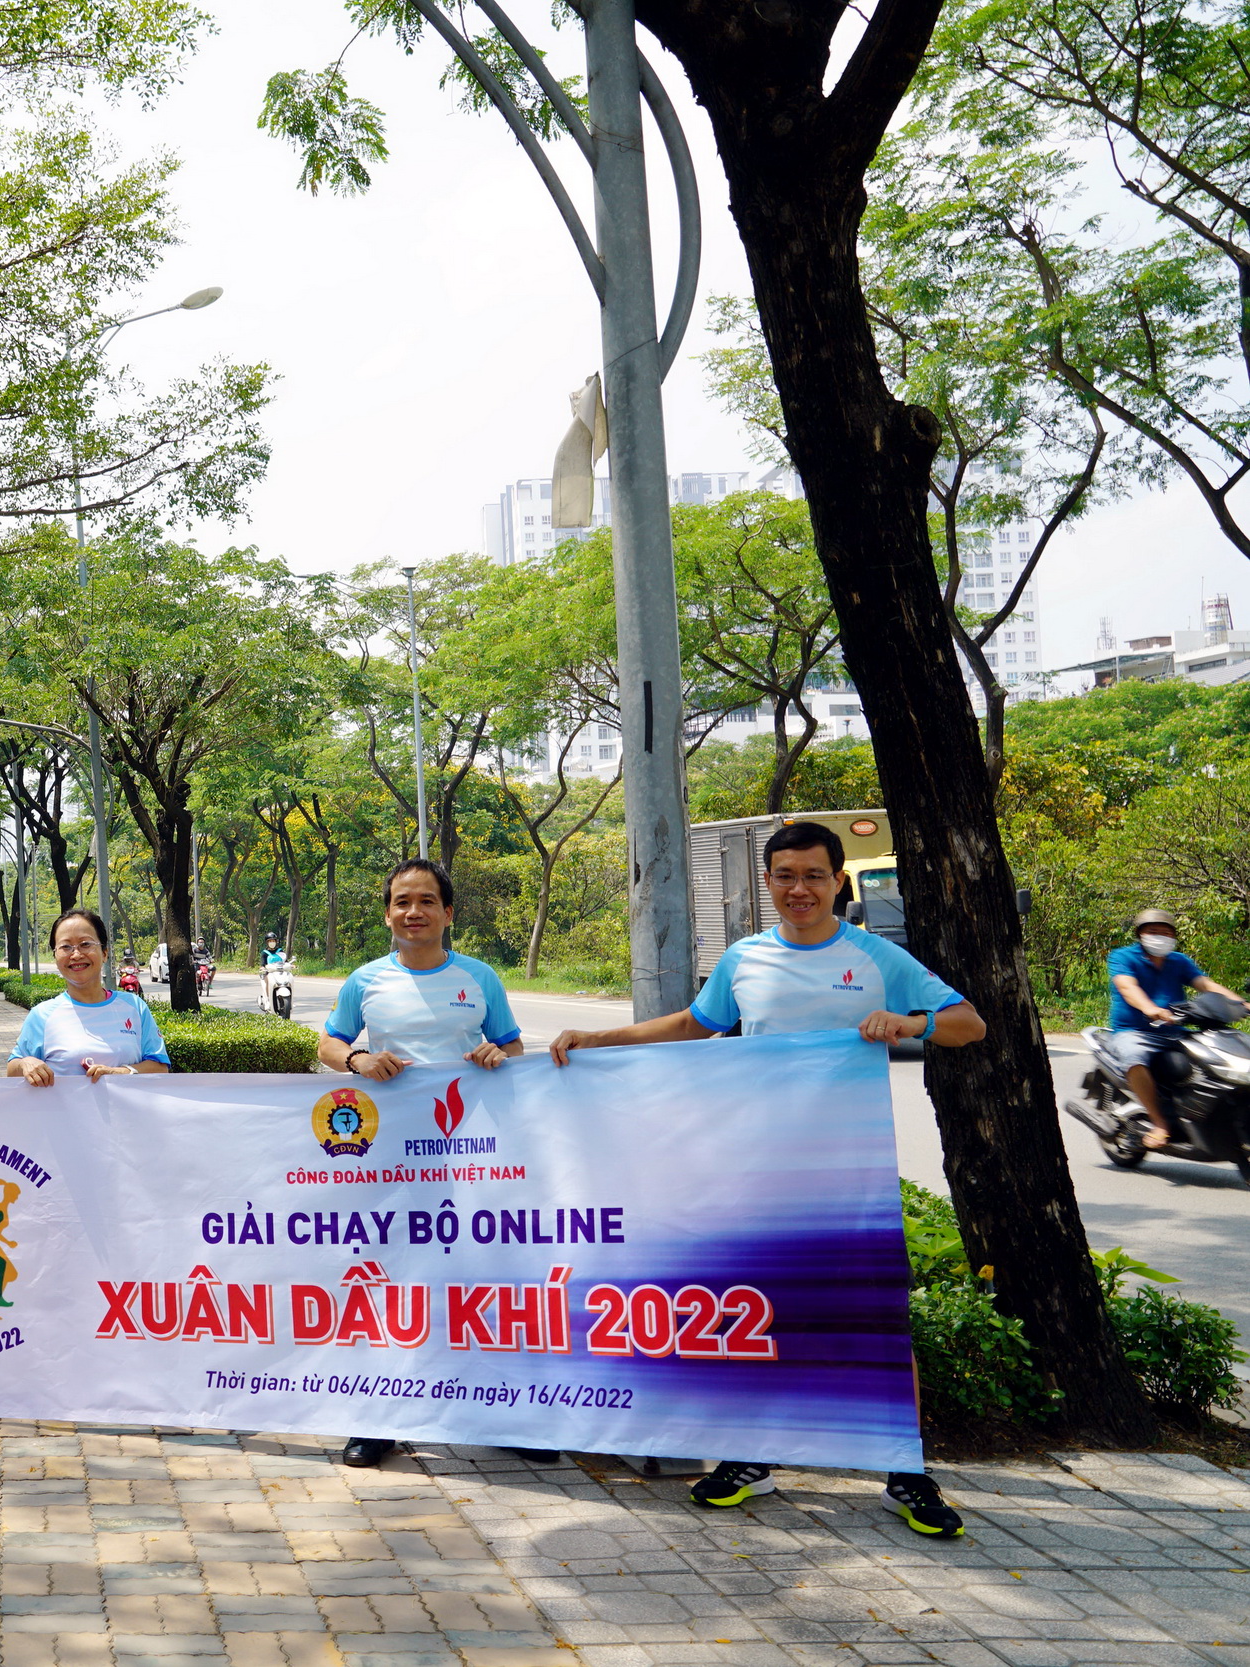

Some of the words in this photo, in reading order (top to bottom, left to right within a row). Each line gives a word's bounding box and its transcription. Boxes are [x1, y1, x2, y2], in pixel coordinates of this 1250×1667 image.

[333, 1144, 360, 1155] CĐVN
[405, 1136, 496, 1156] PETROVIETNAM
[286, 1166, 329, 1184] CÔNG
[332, 1165, 378, 1184] ĐOÀN
[382, 1163, 416, 1184] DẦU
[421, 1163, 448, 1182] KHÍ
[451, 1163, 486, 1185] VIỆT
[489, 1165, 526, 1180] NAM
[201, 1201, 275, 1246] GIẢI
[286, 1209, 395, 1256] CHẠY
[408, 1198, 460, 1255] BỘ
[471, 1206, 625, 1246] ONLINE
[95, 1263, 275, 1346] XUÂN
[291, 1260, 432, 1350] DẦU
[445, 1262, 573, 1355] KHÍ
[585, 1283, 779, 1361] 2022
[205, 1370, 246, 1390] Thời
[250, 1374, 297, 1395] gian:
[302, 1372, 324, 1394] từ
[327, 1374, 426, 1398] 06/4/2022
[431, 1378, 468, 1401] đến
[472, 1384, 521, 1408] ngày
[527, 1383, 634, 1410] 16/4/2022
